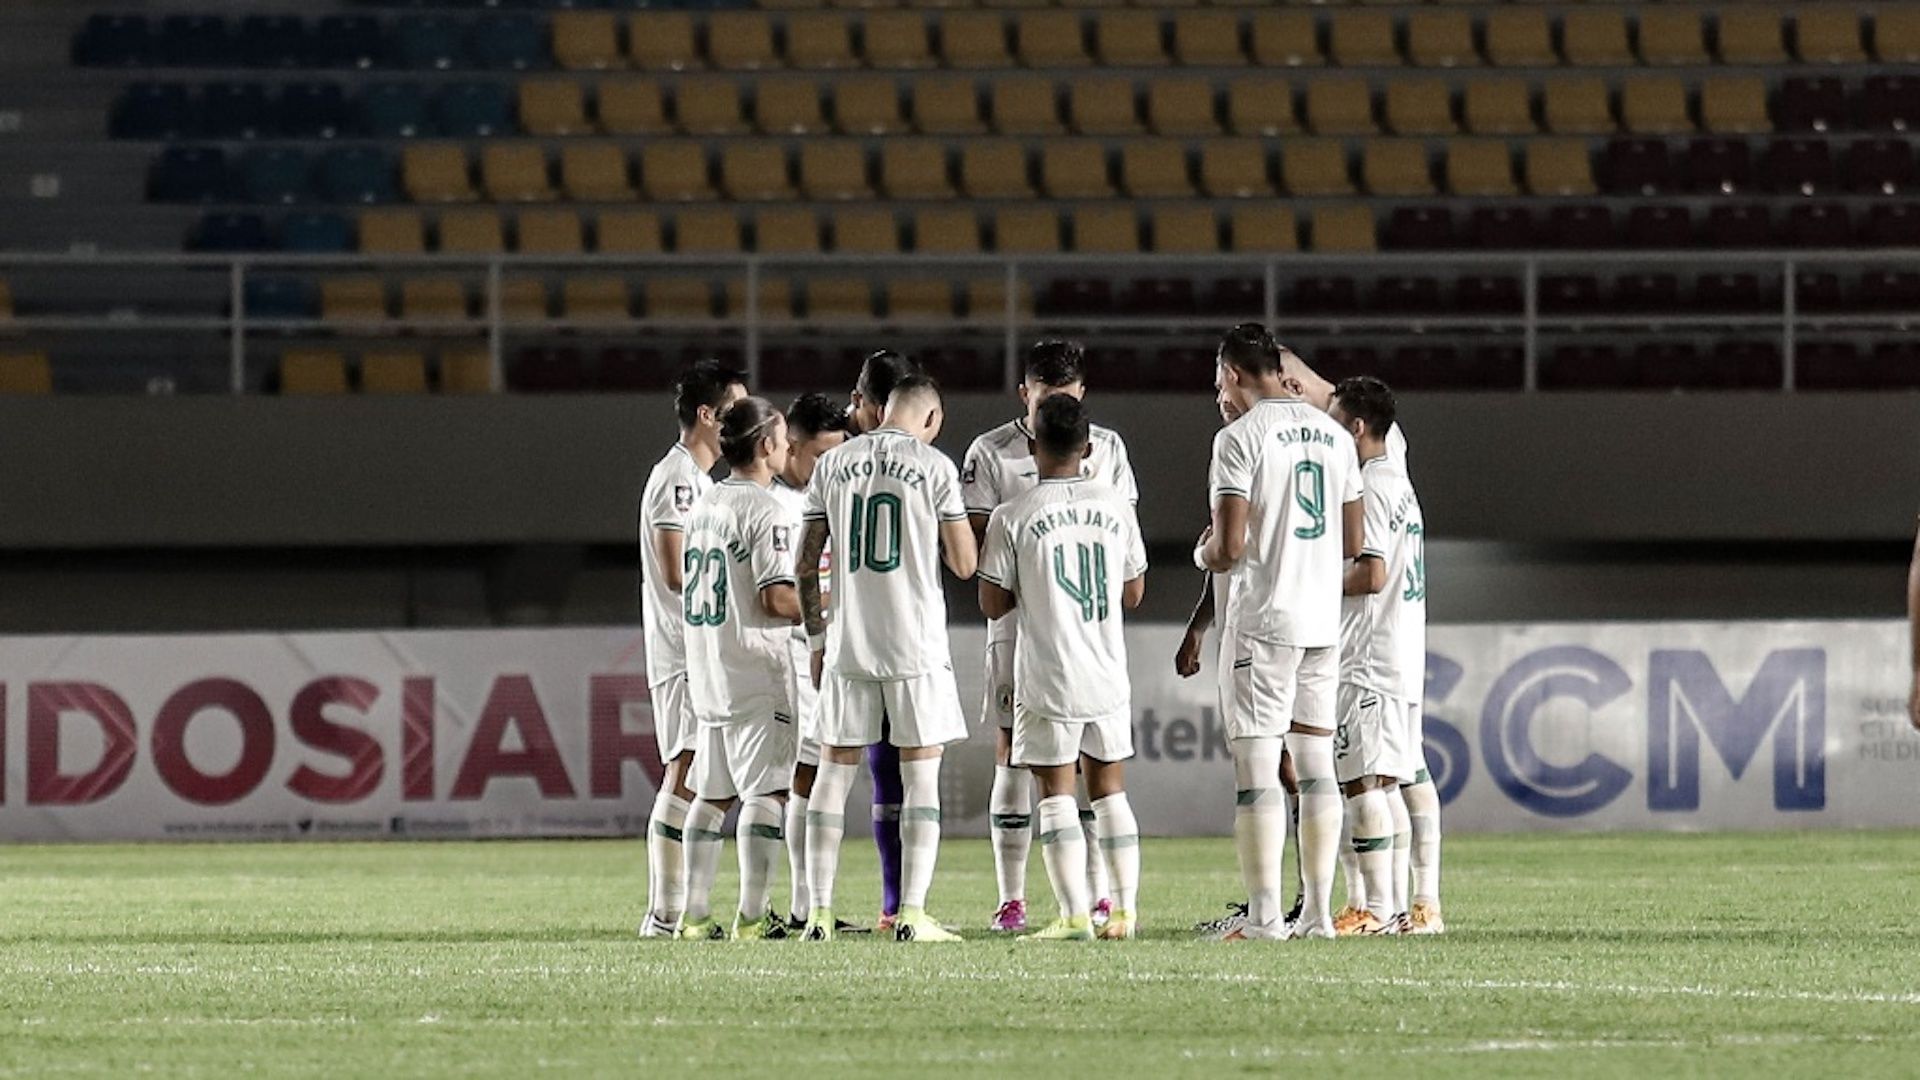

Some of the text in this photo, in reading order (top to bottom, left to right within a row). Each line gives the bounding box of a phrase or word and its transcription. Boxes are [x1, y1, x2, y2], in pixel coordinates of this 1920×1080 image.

[880, 460, 926, 490] VELEZ
[1277, 427, 1334, 450] SADDAM
[849, 492, 902, 573] 10
[1030, 509, 1120, 541] IRFAN JAYA
[1294, 461, 1326, 540] 9
[685, 548, 726, 626] 23
[1054, 542, 1108, 622] 41
[0, 676, 664, 806] DOSIAR
[1136, 707, 1232, 761] tek
